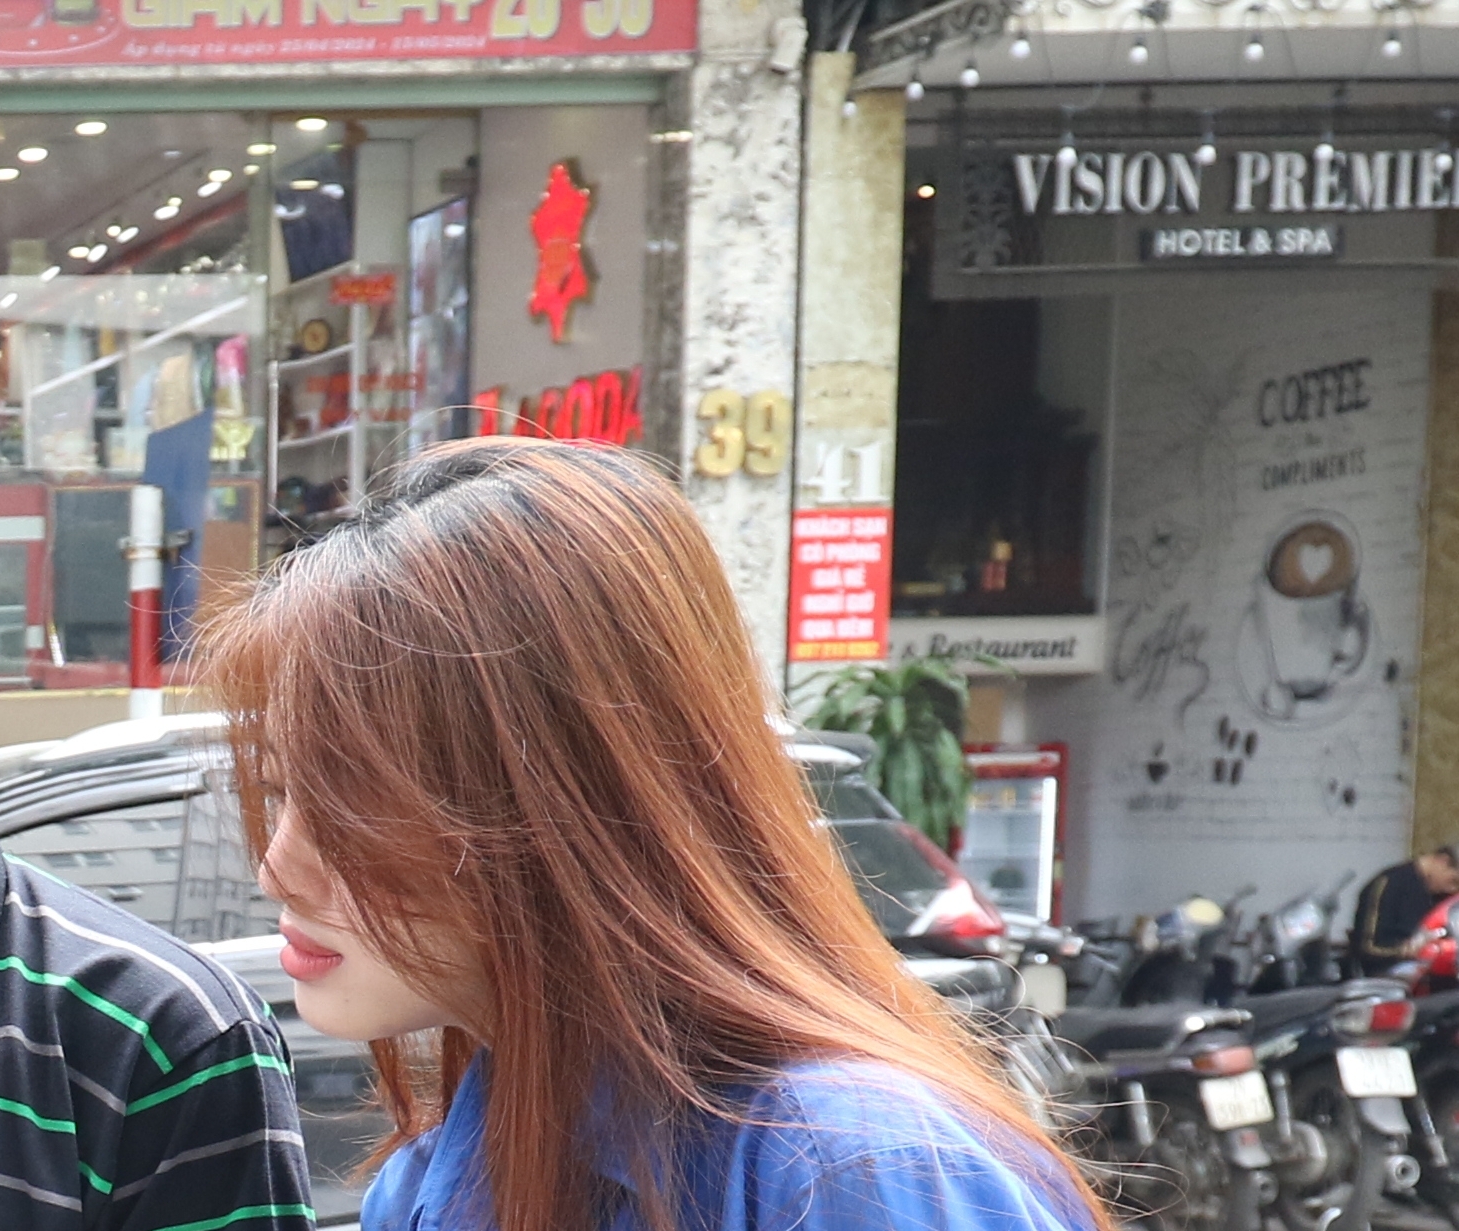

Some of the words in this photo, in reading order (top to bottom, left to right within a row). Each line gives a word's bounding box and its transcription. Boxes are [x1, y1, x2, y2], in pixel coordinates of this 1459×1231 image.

[1013, 150, 1202, 215] VISION
[1235, 149, 1459, 211] PREMIE
[1155, 227, 1245, 257] HOTEL
[1246, 228, 1273, 256] &
[1281, 228, 1333, 256] SPA
[1257, 356, 1373, 428] COFFEE
[694, 388, 793, 478] 39
[800, 442, 891, 503] 41
